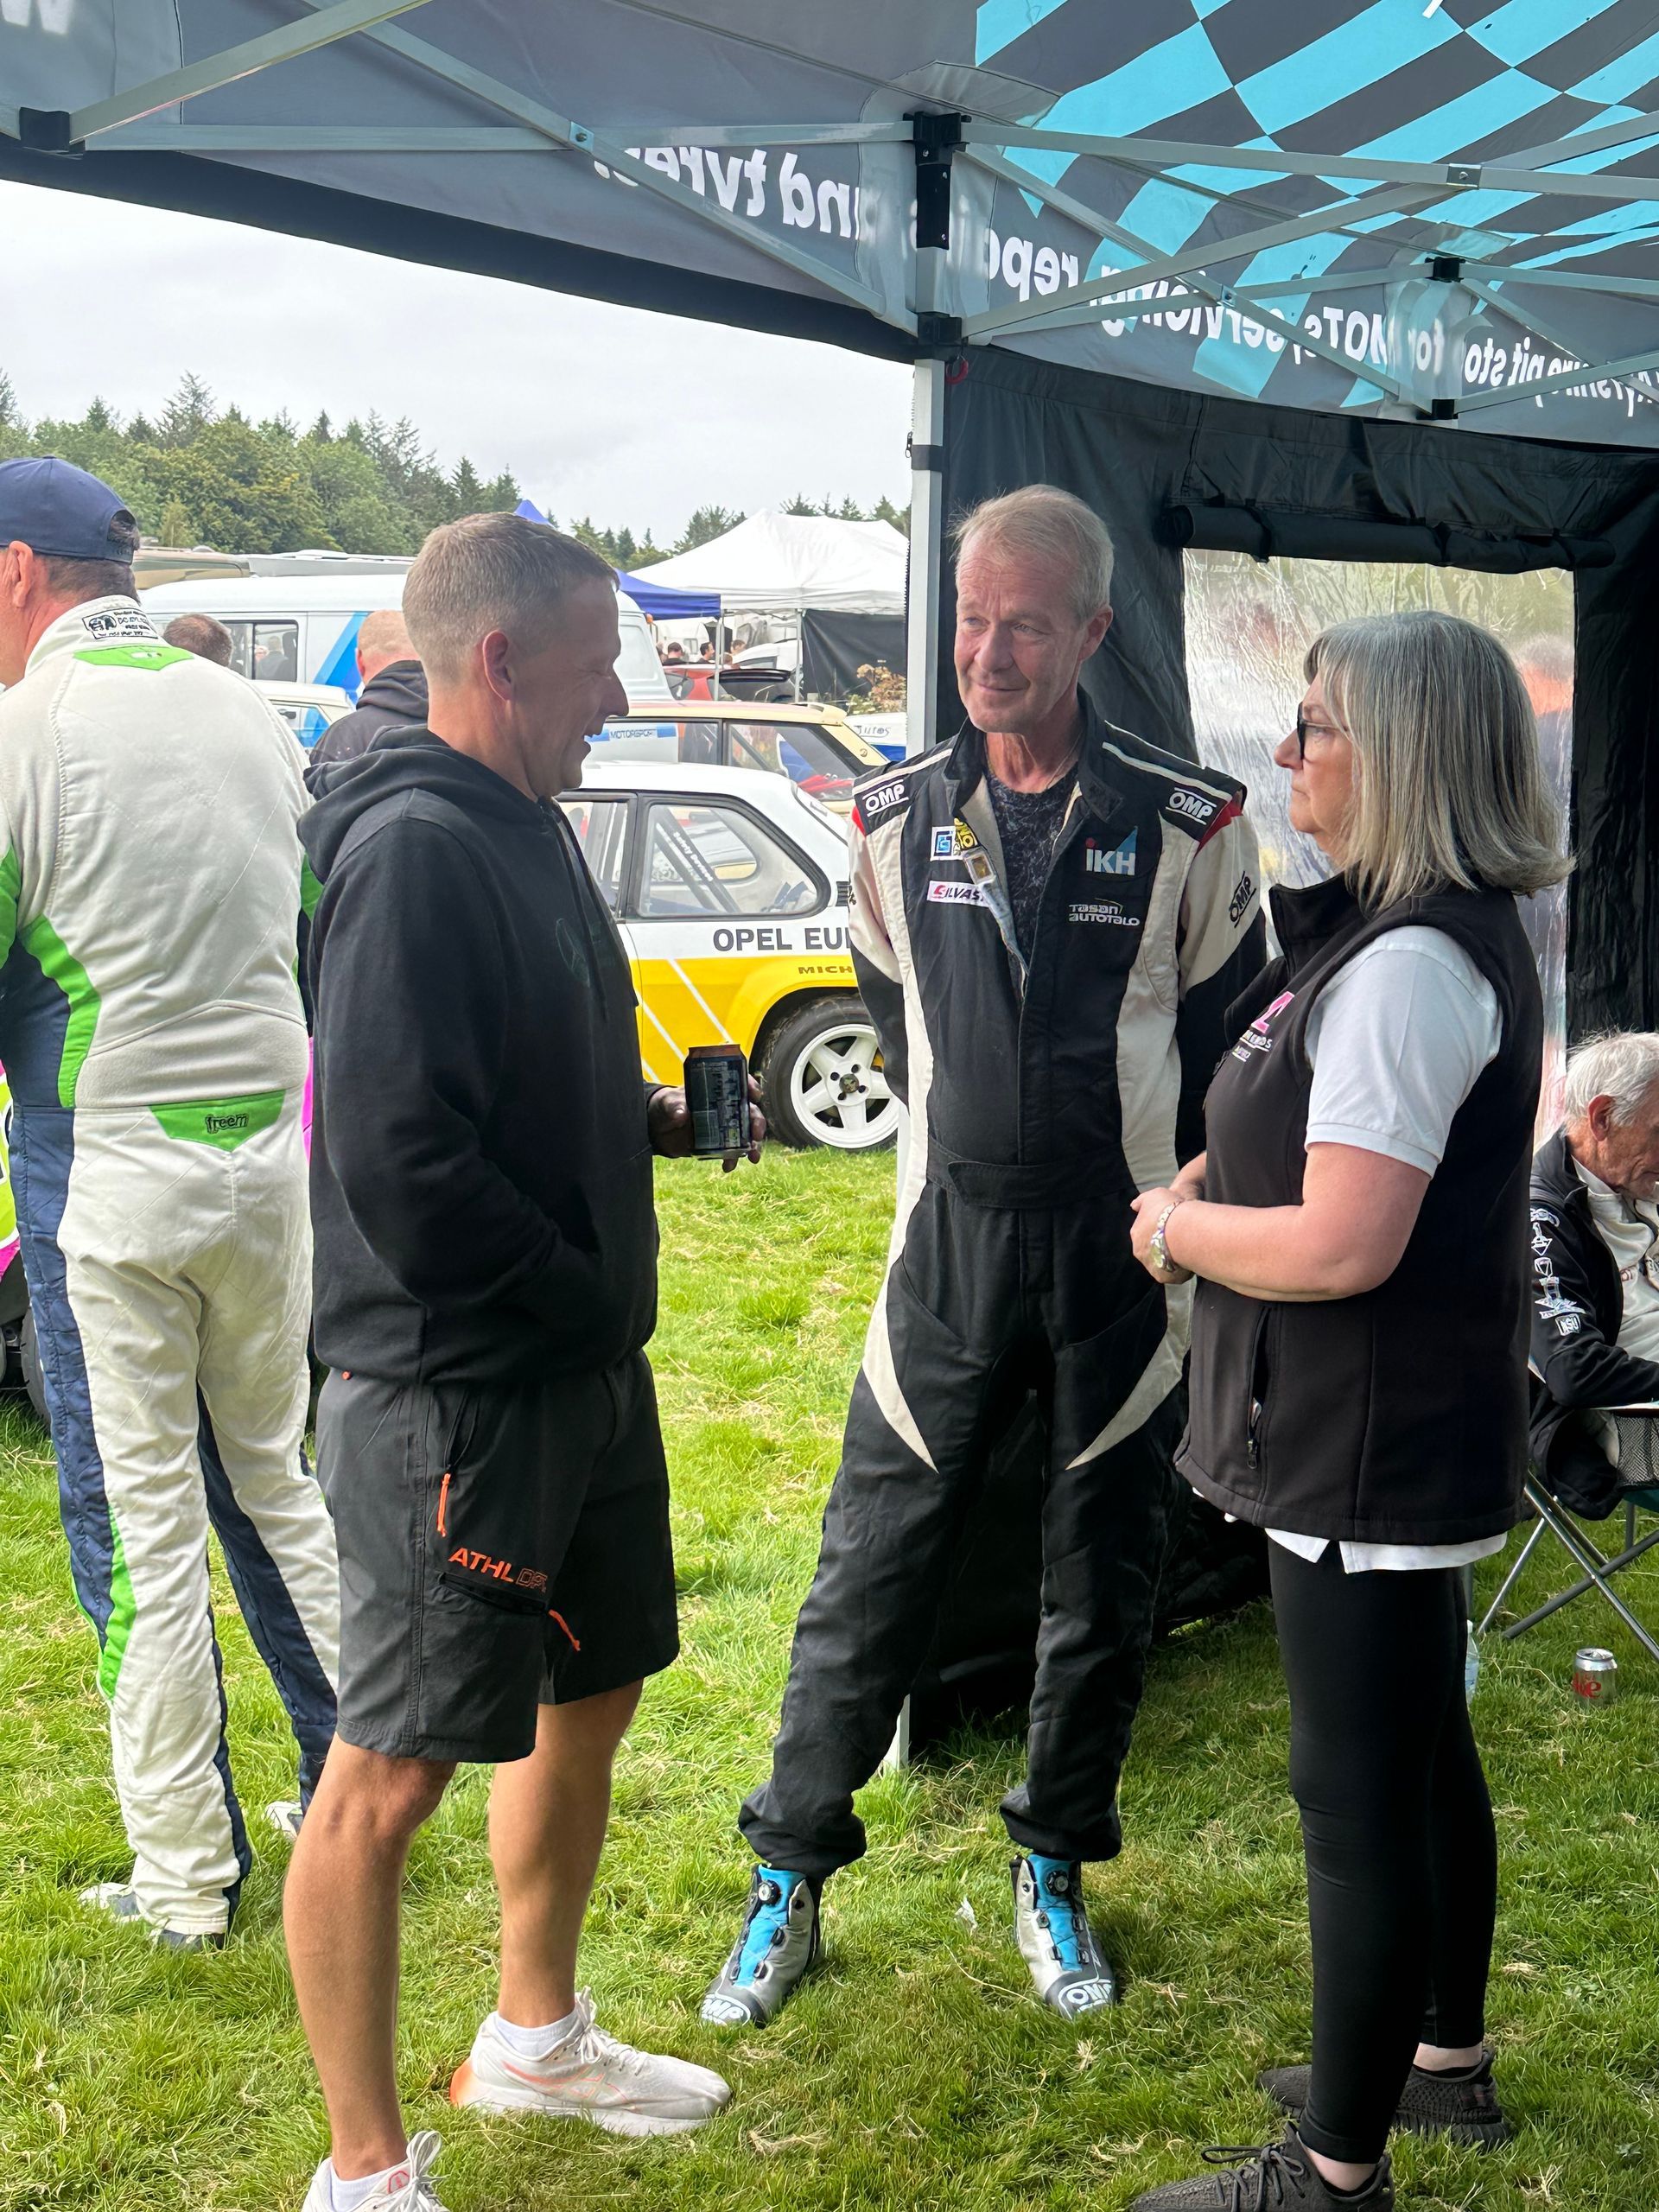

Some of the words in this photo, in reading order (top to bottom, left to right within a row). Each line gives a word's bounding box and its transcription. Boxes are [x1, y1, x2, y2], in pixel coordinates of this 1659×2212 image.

[865, 784, 905, 811] OMP
[1169, 791, 1213, 819] OMP
[933, 884, 984, 902] SILVAS
[1230, 876, 1251, 923] OMP
[713, 928, 792, 952] OPEL
[804, 927, 851, 950] EU
[448, 1547, 514, 1583] ATHL
